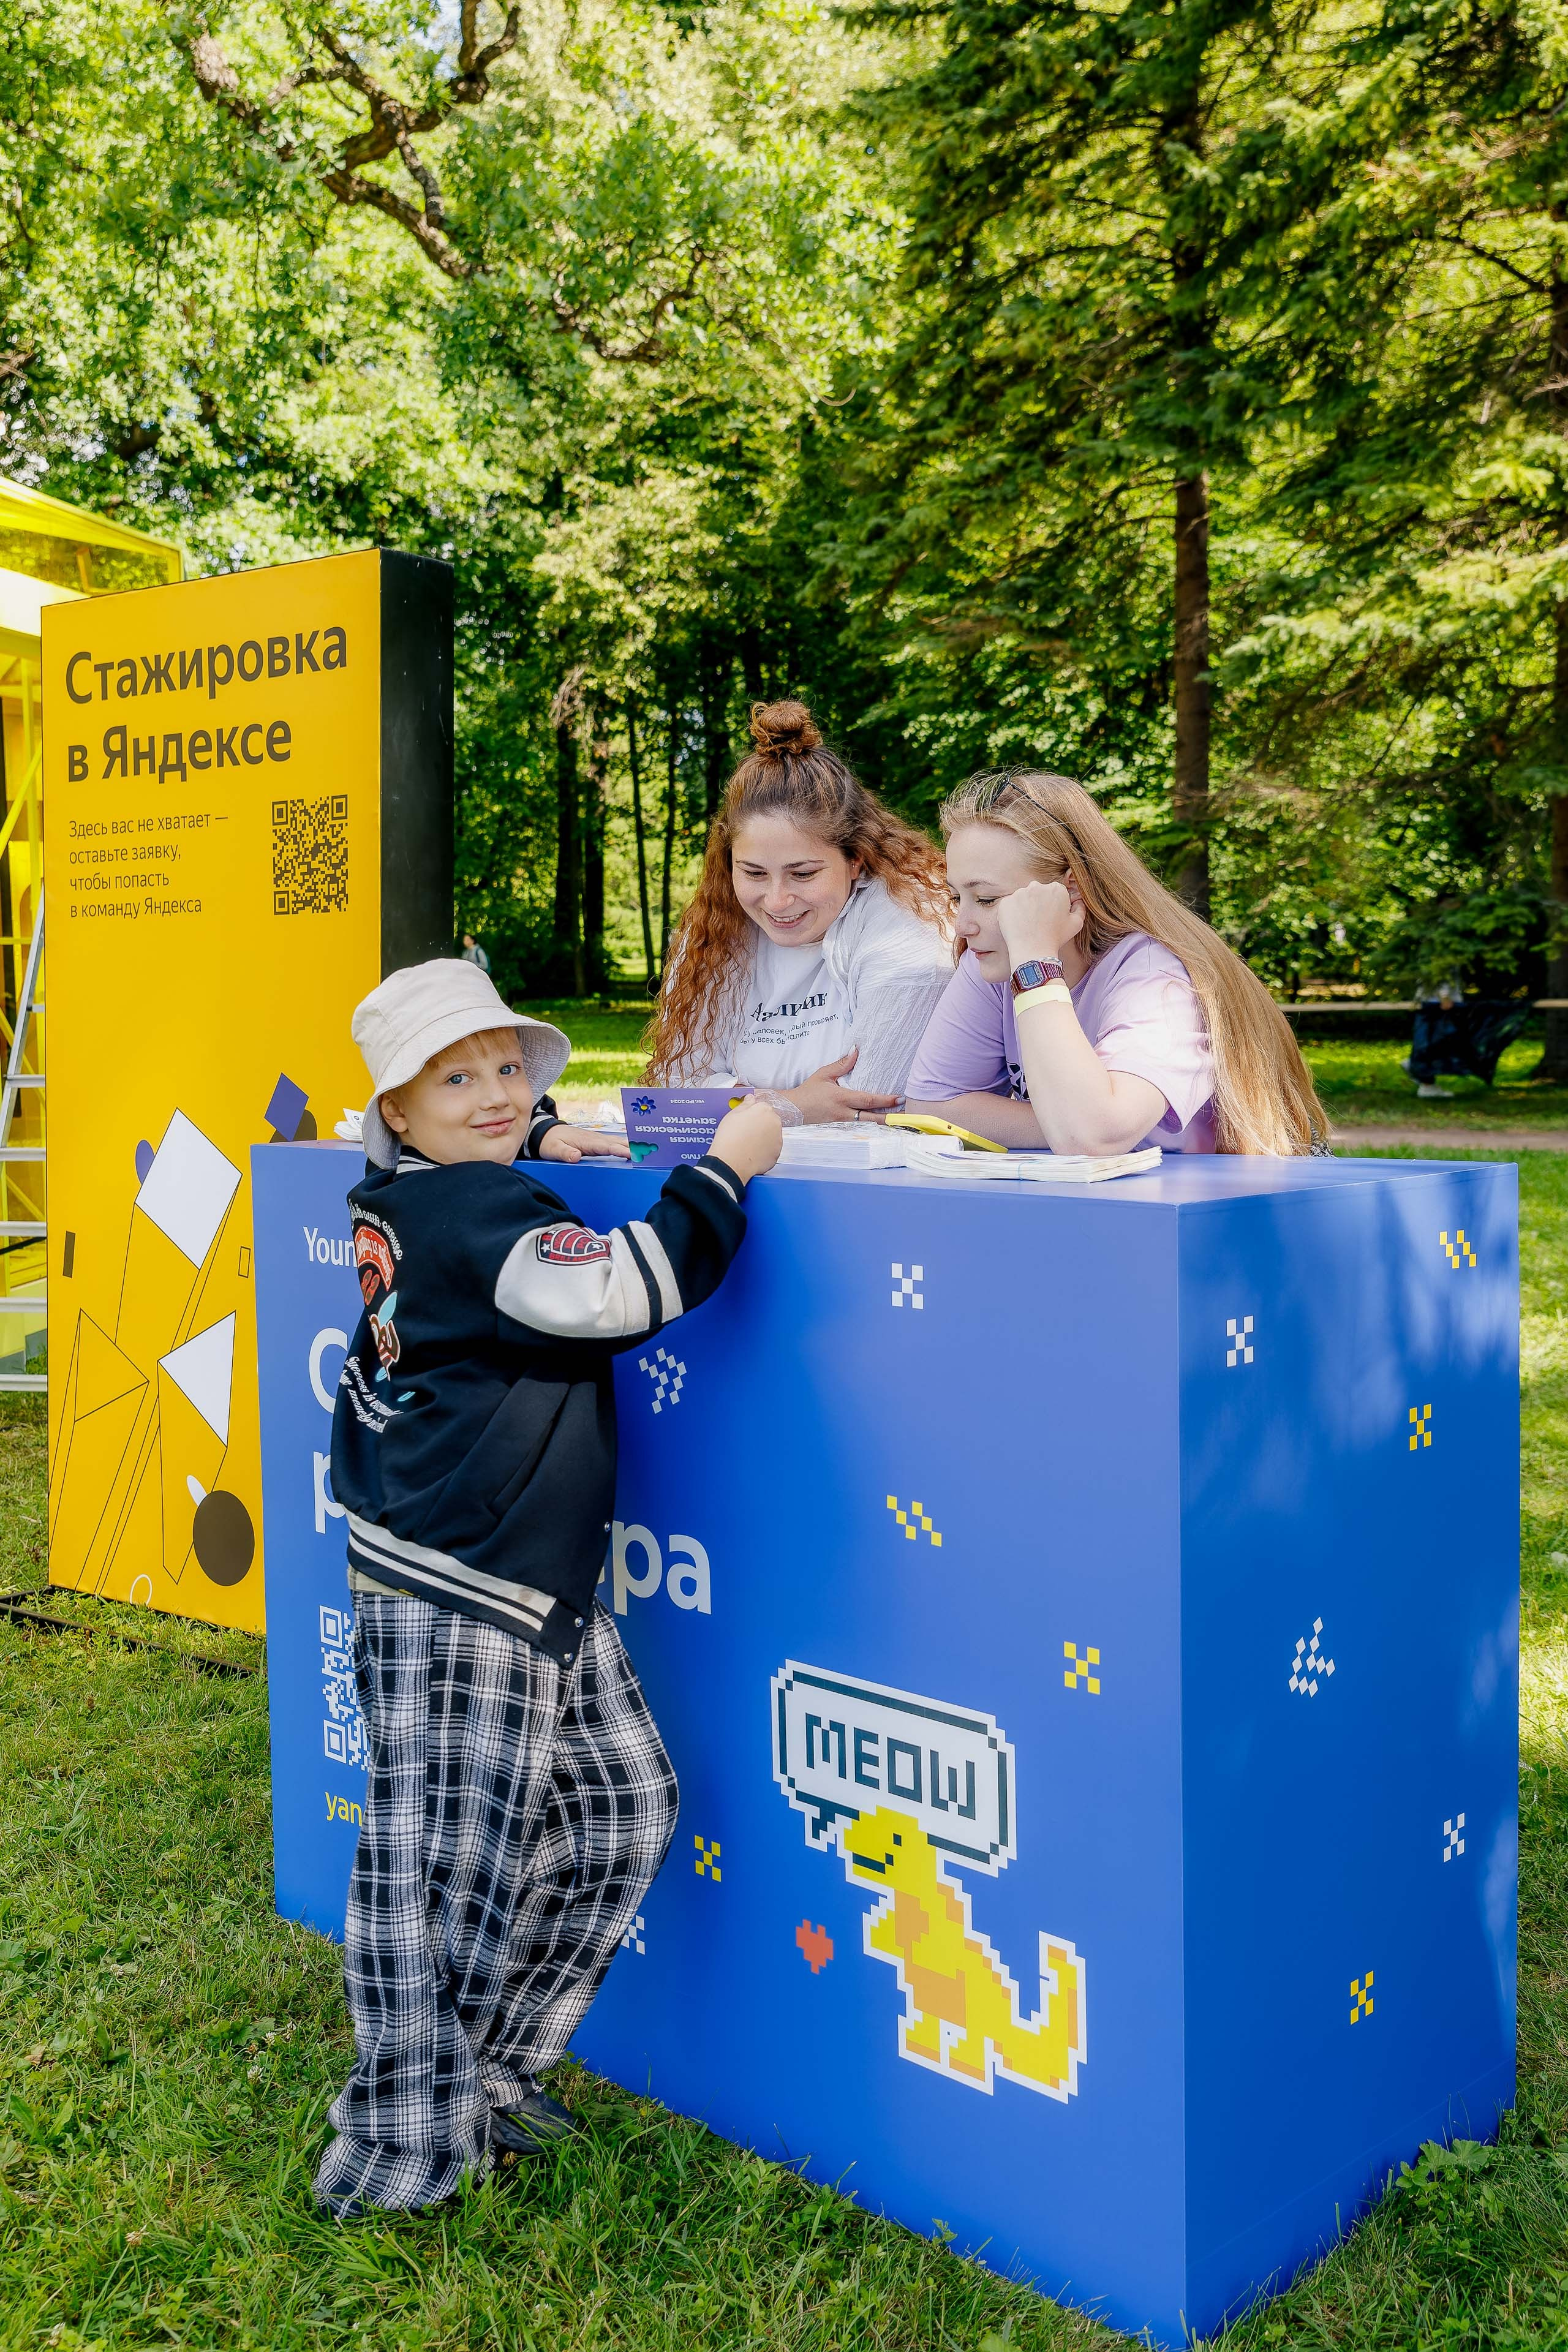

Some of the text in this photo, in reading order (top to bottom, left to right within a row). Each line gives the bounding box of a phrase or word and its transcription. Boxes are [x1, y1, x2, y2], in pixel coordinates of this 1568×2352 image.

[66, 626, 347, 704] Стажировка
[68, 720, 292, 785] в Яндексе
[69, 820, 108, 840] Здесь
[111, 820, 134, 835] вас
[138, 818, 154, 832] не
[157, 814, 211, 831] хватает
[69, 844, 181, 864] оставьте заявку,
[70, 872, 169, 891] чтобы попасть
[70, 897, 202, 919] в команду Яндекса
[635, 1125, 717, 1134] ассическая
[662, 1116, 717, 1125] зачетка
[303, 1226, 358, 1267] Youn
[805, 1712, 976, 1821] MEOW
[325, 1791, 366, 1827] yan
